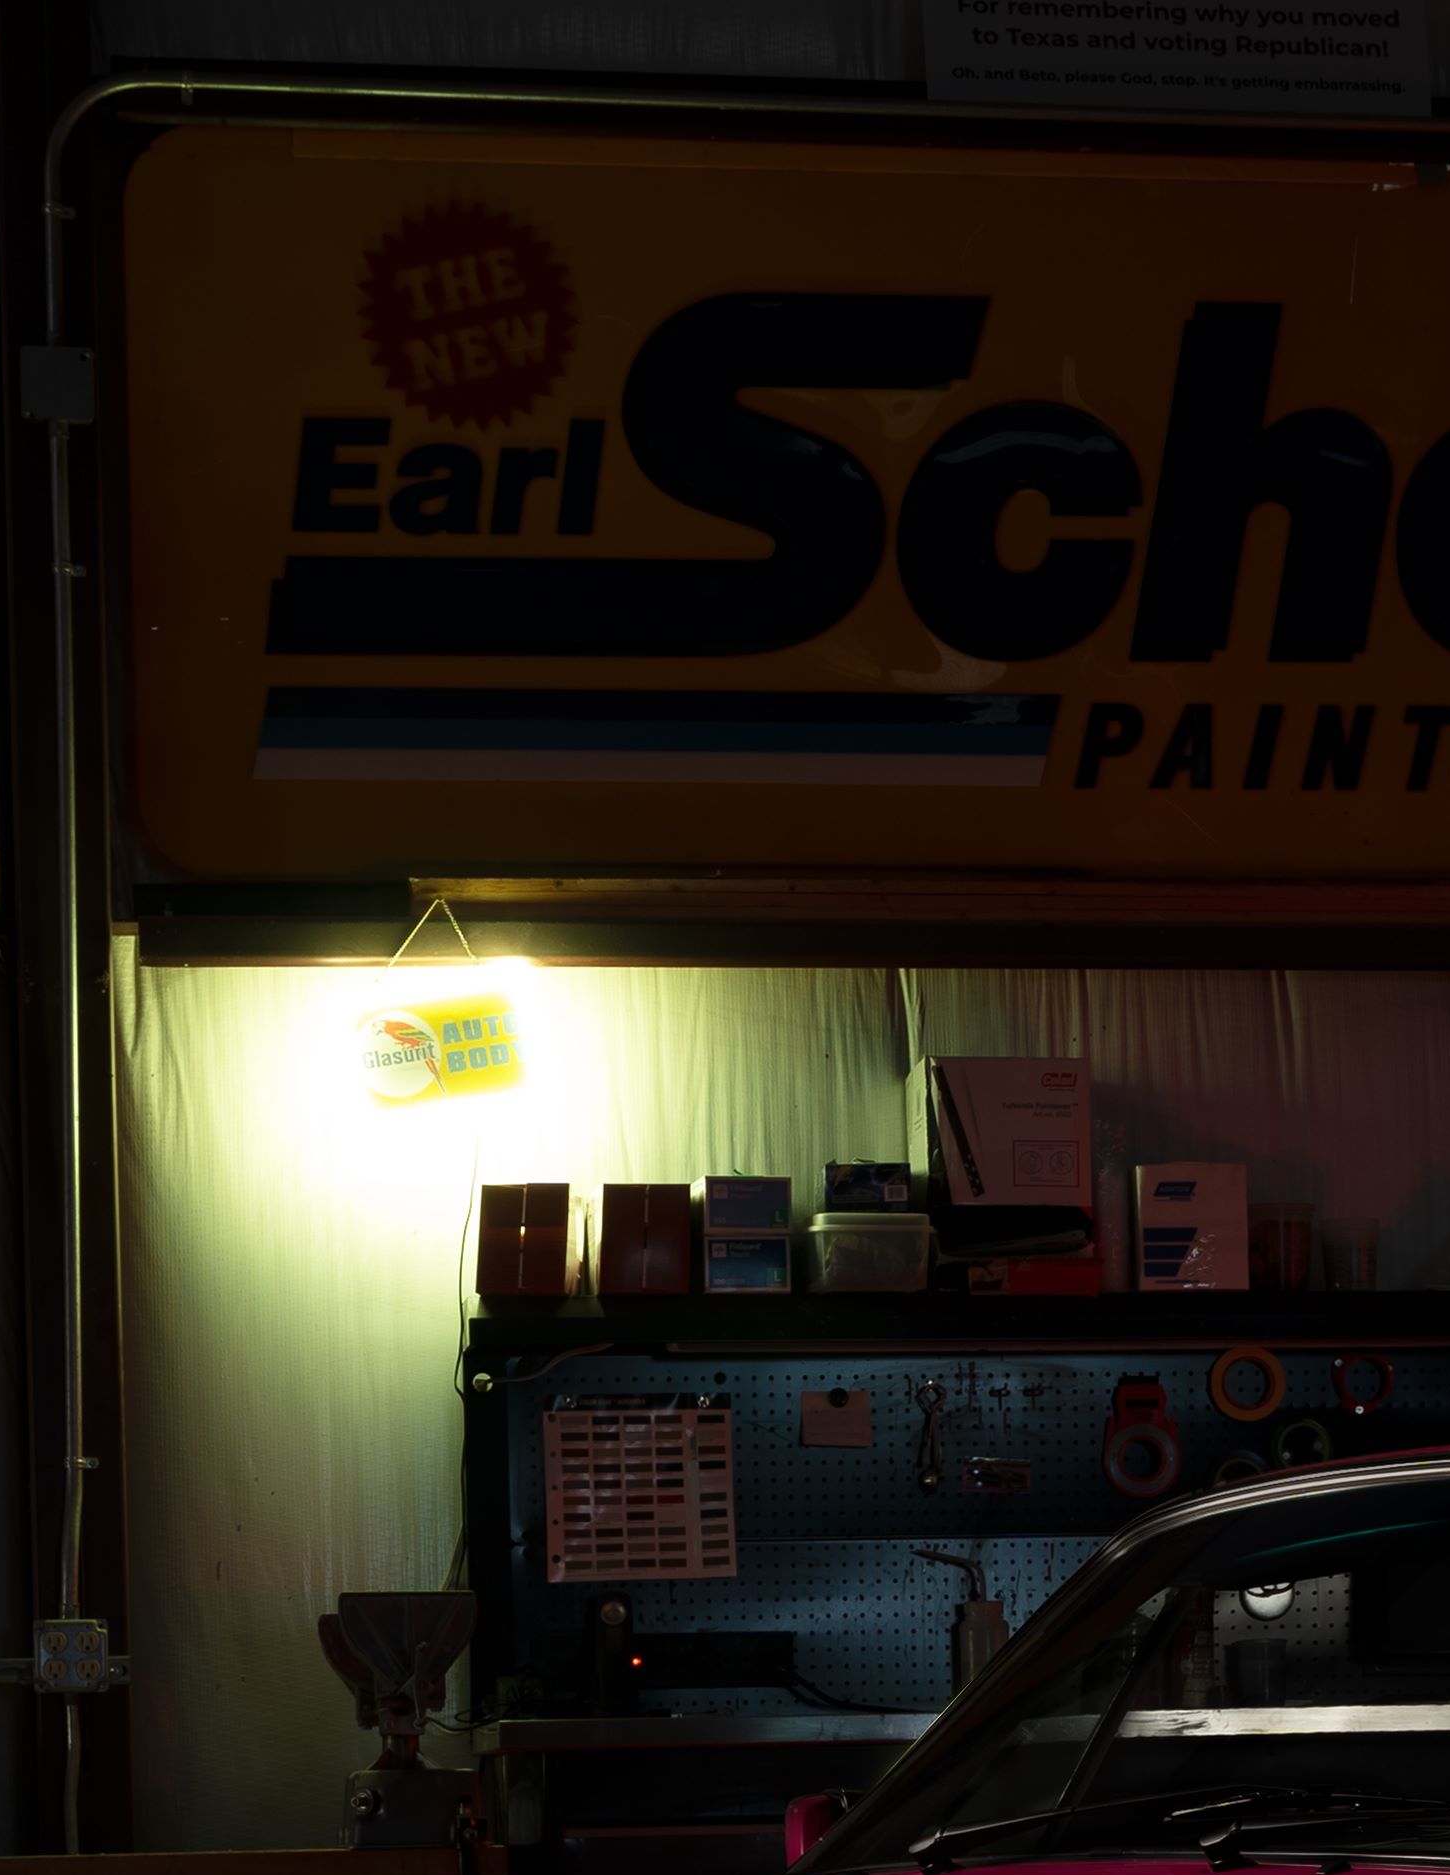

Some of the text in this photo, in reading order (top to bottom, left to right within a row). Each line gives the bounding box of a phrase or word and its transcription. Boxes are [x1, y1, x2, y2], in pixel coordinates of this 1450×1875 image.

[972, 26, 1389, 58] to Texas and voting Republican!
[1007, 0, 1186, 25] remembering
[1195, 7, 1248, 27] why
[1257, 12, 1306, 29] you
[1313, 8, 1400, 28] moved
[951, 66, 1407, 95] Oh, and Beto, please God, stop. getting embarrassing.
[395, 248, 527, 321] THE
[406, 310, 549, 392] NEW
[292, 416, 605, 536] Earl
[362, 1012, 519, 1070] Glasurit AUTO
